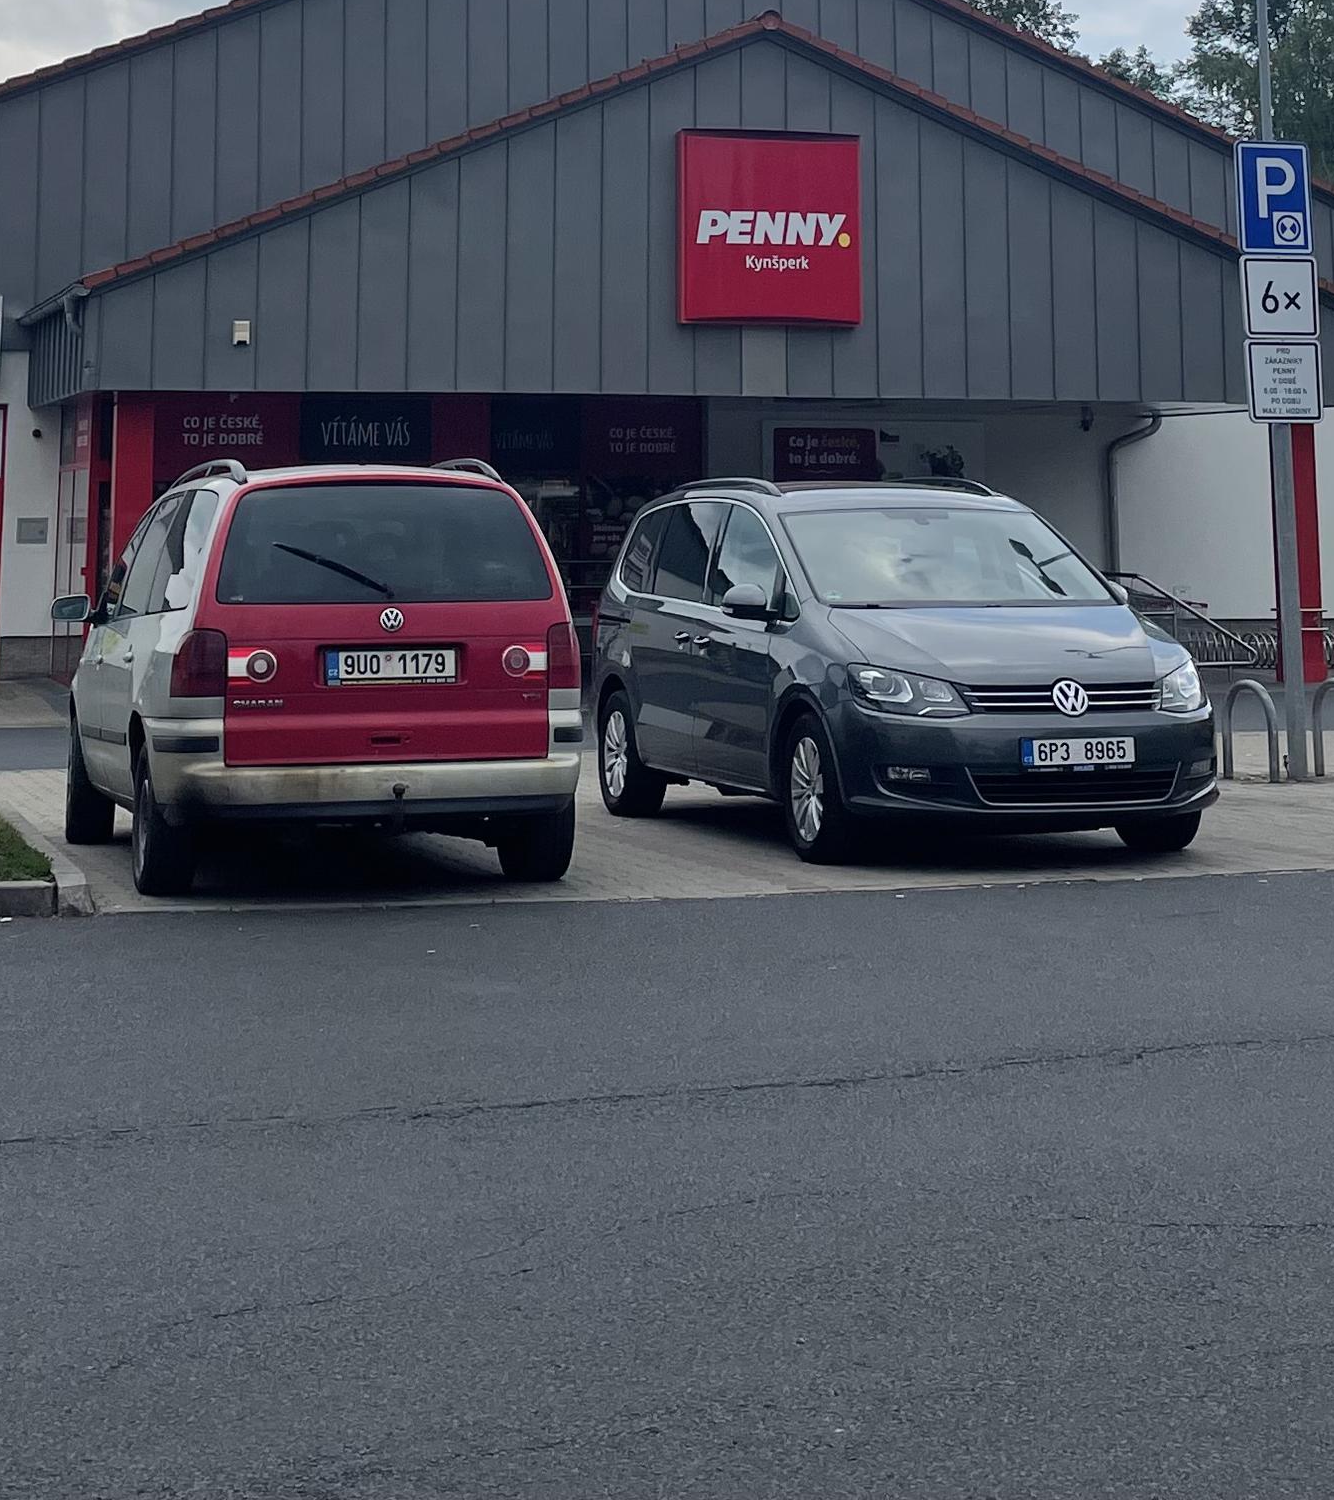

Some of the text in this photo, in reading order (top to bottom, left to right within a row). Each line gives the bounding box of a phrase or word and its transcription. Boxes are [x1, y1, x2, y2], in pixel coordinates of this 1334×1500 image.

[1256, 157, 1296, 218] P
[745, 254, 809, 272] Kynšperk
[183, 413, 264, 431] CO JE ČESKÉ,
[321, 415, 411, 446] VÍTÁME VÁS
[182, 430, 264, 448] TO JE DOBRÉ
[788, 435, 805, 448] Co
[397, 653, 446, 675] 1179
[1038, 742, 1070, 762] 6P3
[1084, 740, 1126, 760] 8965
